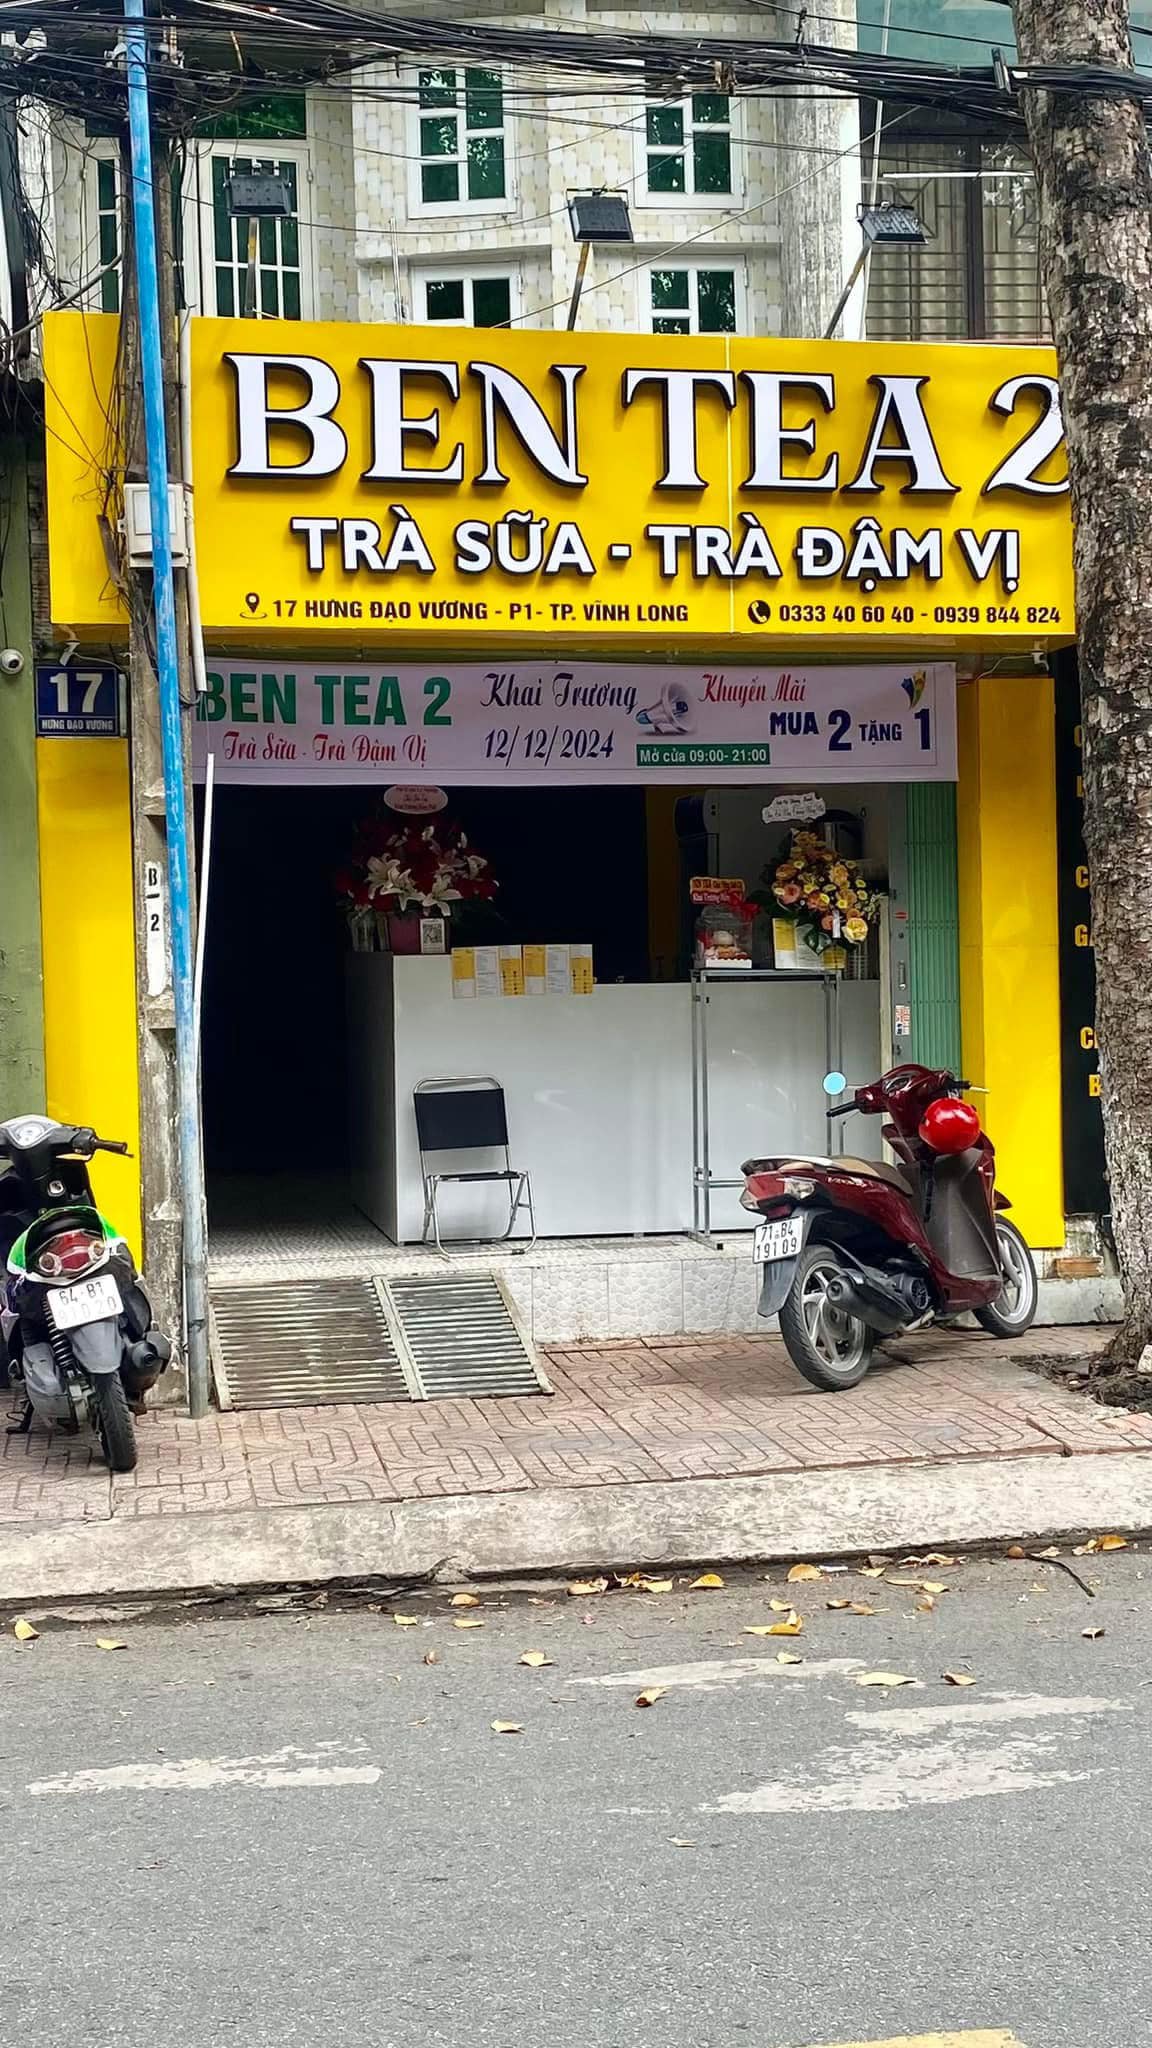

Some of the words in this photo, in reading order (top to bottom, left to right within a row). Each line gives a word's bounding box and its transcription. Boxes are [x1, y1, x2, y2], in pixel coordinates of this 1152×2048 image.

[224, 352, 588, 488] BEN
[621, 368, 961, 496] TEA
[981, 374, 1069, 497] 2
[290, 504, 435, 574] TRÀ
[454, 509, 596, 577] SỮA
[644, 512, 783, 579] TRÀ
[793, 517, 942, 592] ĐẬM
[956, 528, 1020, 594] VỊ
[273, 599, 297, 617] 17
[305, 599, 363, 618] HƯNG
[370, 601, 411, 623] ĐẠO
[419, 600, 488, 620] VƯƠNG
[550, 603, 577, 621] TP.
[583, 600, 629, 621] VĨNH
[637, 605, 688, 621] LONG
[779, 605, 826, 621] 0333
[832, 605, 855, 622] 40
[862, 606, 884, 622] 60
[891, 606, 914, 622] 40
[934, 606, 979, 623] 0939
[986, 606, 1020, 623] 844
[1027, 607, 1061, 623] 824
[50, 672, 103, 713] 17
[196, 672, 297, 725] BEN
[314, 675, 407, 725] TEA
[423, 676, 452, 726] 2
[480, 673, 543, 707] Khai
[552, 673, 639, 714] Trương
[223, 730, 257, 761] Trà
[263, 731, 297, 761] Sữa
[313, 733, 346, 762] Trà
[352, 734, 396, 768] Đậm
[403, 734, 427, 768] Vị
[485, 725, 615, 767] 12/12/2024
[769, 712, 819, 736] MUA
[828, 709, 853, 751] 2
[858, 719, 902, 746] TẶNG
[914, 708, 931, 751] 1
[640, 748, 659, 762] Mở
[662, 747, 686, 762] cửa
[731, 748, 767, 762] 21:00
[150, 914, 160, 931] 2
